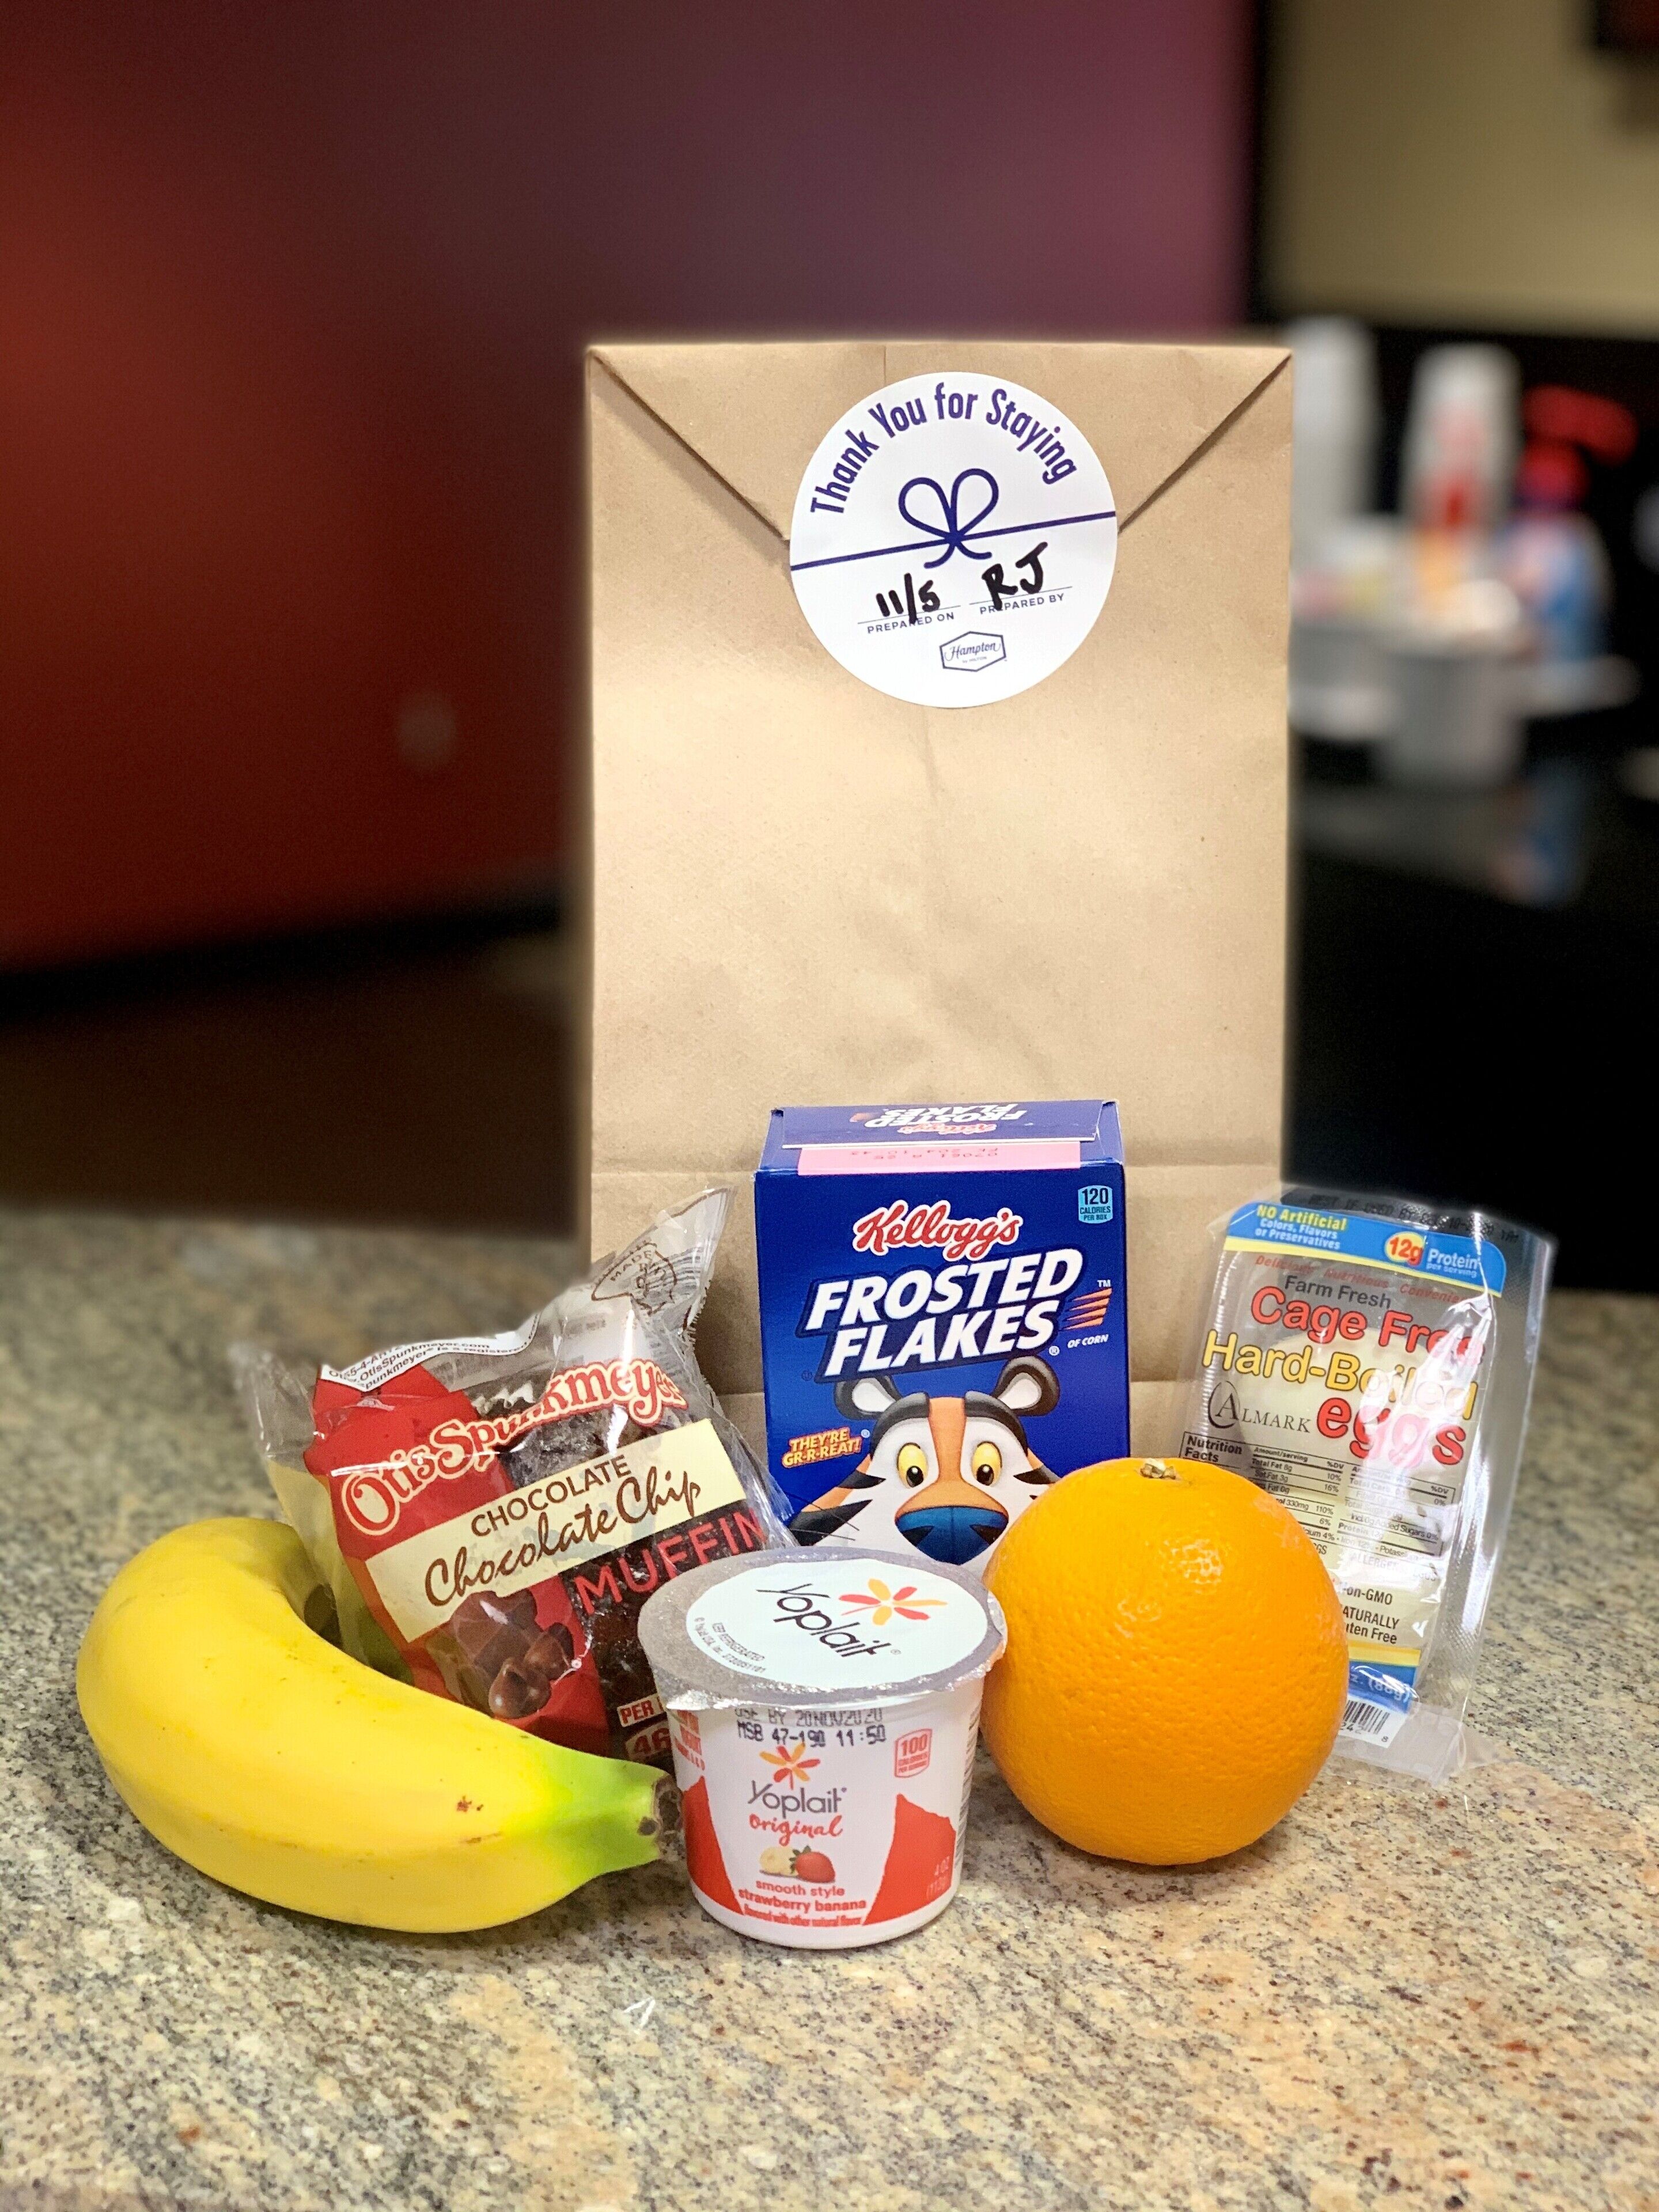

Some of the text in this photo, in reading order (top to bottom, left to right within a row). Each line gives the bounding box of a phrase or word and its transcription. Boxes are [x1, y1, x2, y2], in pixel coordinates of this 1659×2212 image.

[810, 382, 1077, 514] Thank You for Staying
[982, 541, 1048, 611] RJ
[980, 593, 1065, 615] PRPARED BY
[937, 612, 955, 622] ON
[945, 642, 1001, 661] Hampton
[1081, 1188, 1109, 1205] 120
[1080, 1206, 1111, 1215] CALORIES
[1256, 1204, 1348, 1231] NO Artificial
[854, 1202, 1021, 1260] Kellogg's
[1255, 1228, 1341, 1250] or Preservatives
[1260, 1218, 1338, 1239] Colors, Flavors
[1389, 1236, 1423, 1266] 12g
[1427, 1248, 1479, 1270] Protein
[806, 1248, 1084, 1330] FROSTED
[1097, 1279, 1111, 1287] TM
[1285, 1275, 1391, 1309] Farm Fresh
[1251, 1286, 1368, 1343] Cage
[824, 1300, 1058, 1377] FLAKES
[1067, 1334, 1109, 1349] OF CORN
[1214, 1391, 1312, 1434] ALMARK
[790, 1428, 849, 1452] THEY'RE
[1317, 1397, 1467, 1469] eggs
[1184, 1446, 1219, 1463] Facts
[1187, 1435, 1243, 1455] Nutrition
[1254, 1446, 1344, 1469] Amount/serving %DV
[1252, 1458, 1269, 1468] Total
[1270, 1461, 1283, 1470] Fat
[1327, 1472, 1342, 1482] 10%
[342, 1448, 434, 1536] Otis
[1267, 1471, 1279, 1480] Fat
[1324, 1483, 1339, 1493] 16%
[1267, 1483, 1279, 1491] Fat
[1430, 1484, 1449, 1494] %DV
[471, 1454, 632, 1537] CHOCOLATE
[1286, 1499, 1309, 1511] 330mg
[1315, 1505, 1334, 1515] 110%
[1319, 1517, 1331, 1526] 6%
[1400, 1524, 1425, 1538] Sugars
[1426, 1532, 1439, 1541] 0%
[425, 1465, 701, 1607] Chocolate Chip
[1323, 1532, 1335, 1541] 4%
[576, 1508, 768, 1615] MUFFIN
[1343, 1585, 1393, 1606] on-GMO
[756, 1583, 891, 1657] Yoplait
[1342, 1605, 1400, 1630] ATURALLY
[1371, 1627, 1397, 1645] Free
[620, 1700, 654, 1725] PER
[768, 1708, 786, 1725] BY
[737, 1719, 764, 1742] MSB
[836, 1724, 887, 1747] 11:50
[901, 1733, 928, 1756] 100
[748, 1780, 842, 1819] Yoplait
[738, 1888, 867, 1914] strawberry banana
[756, 1880, 845, 1899] smooth style
